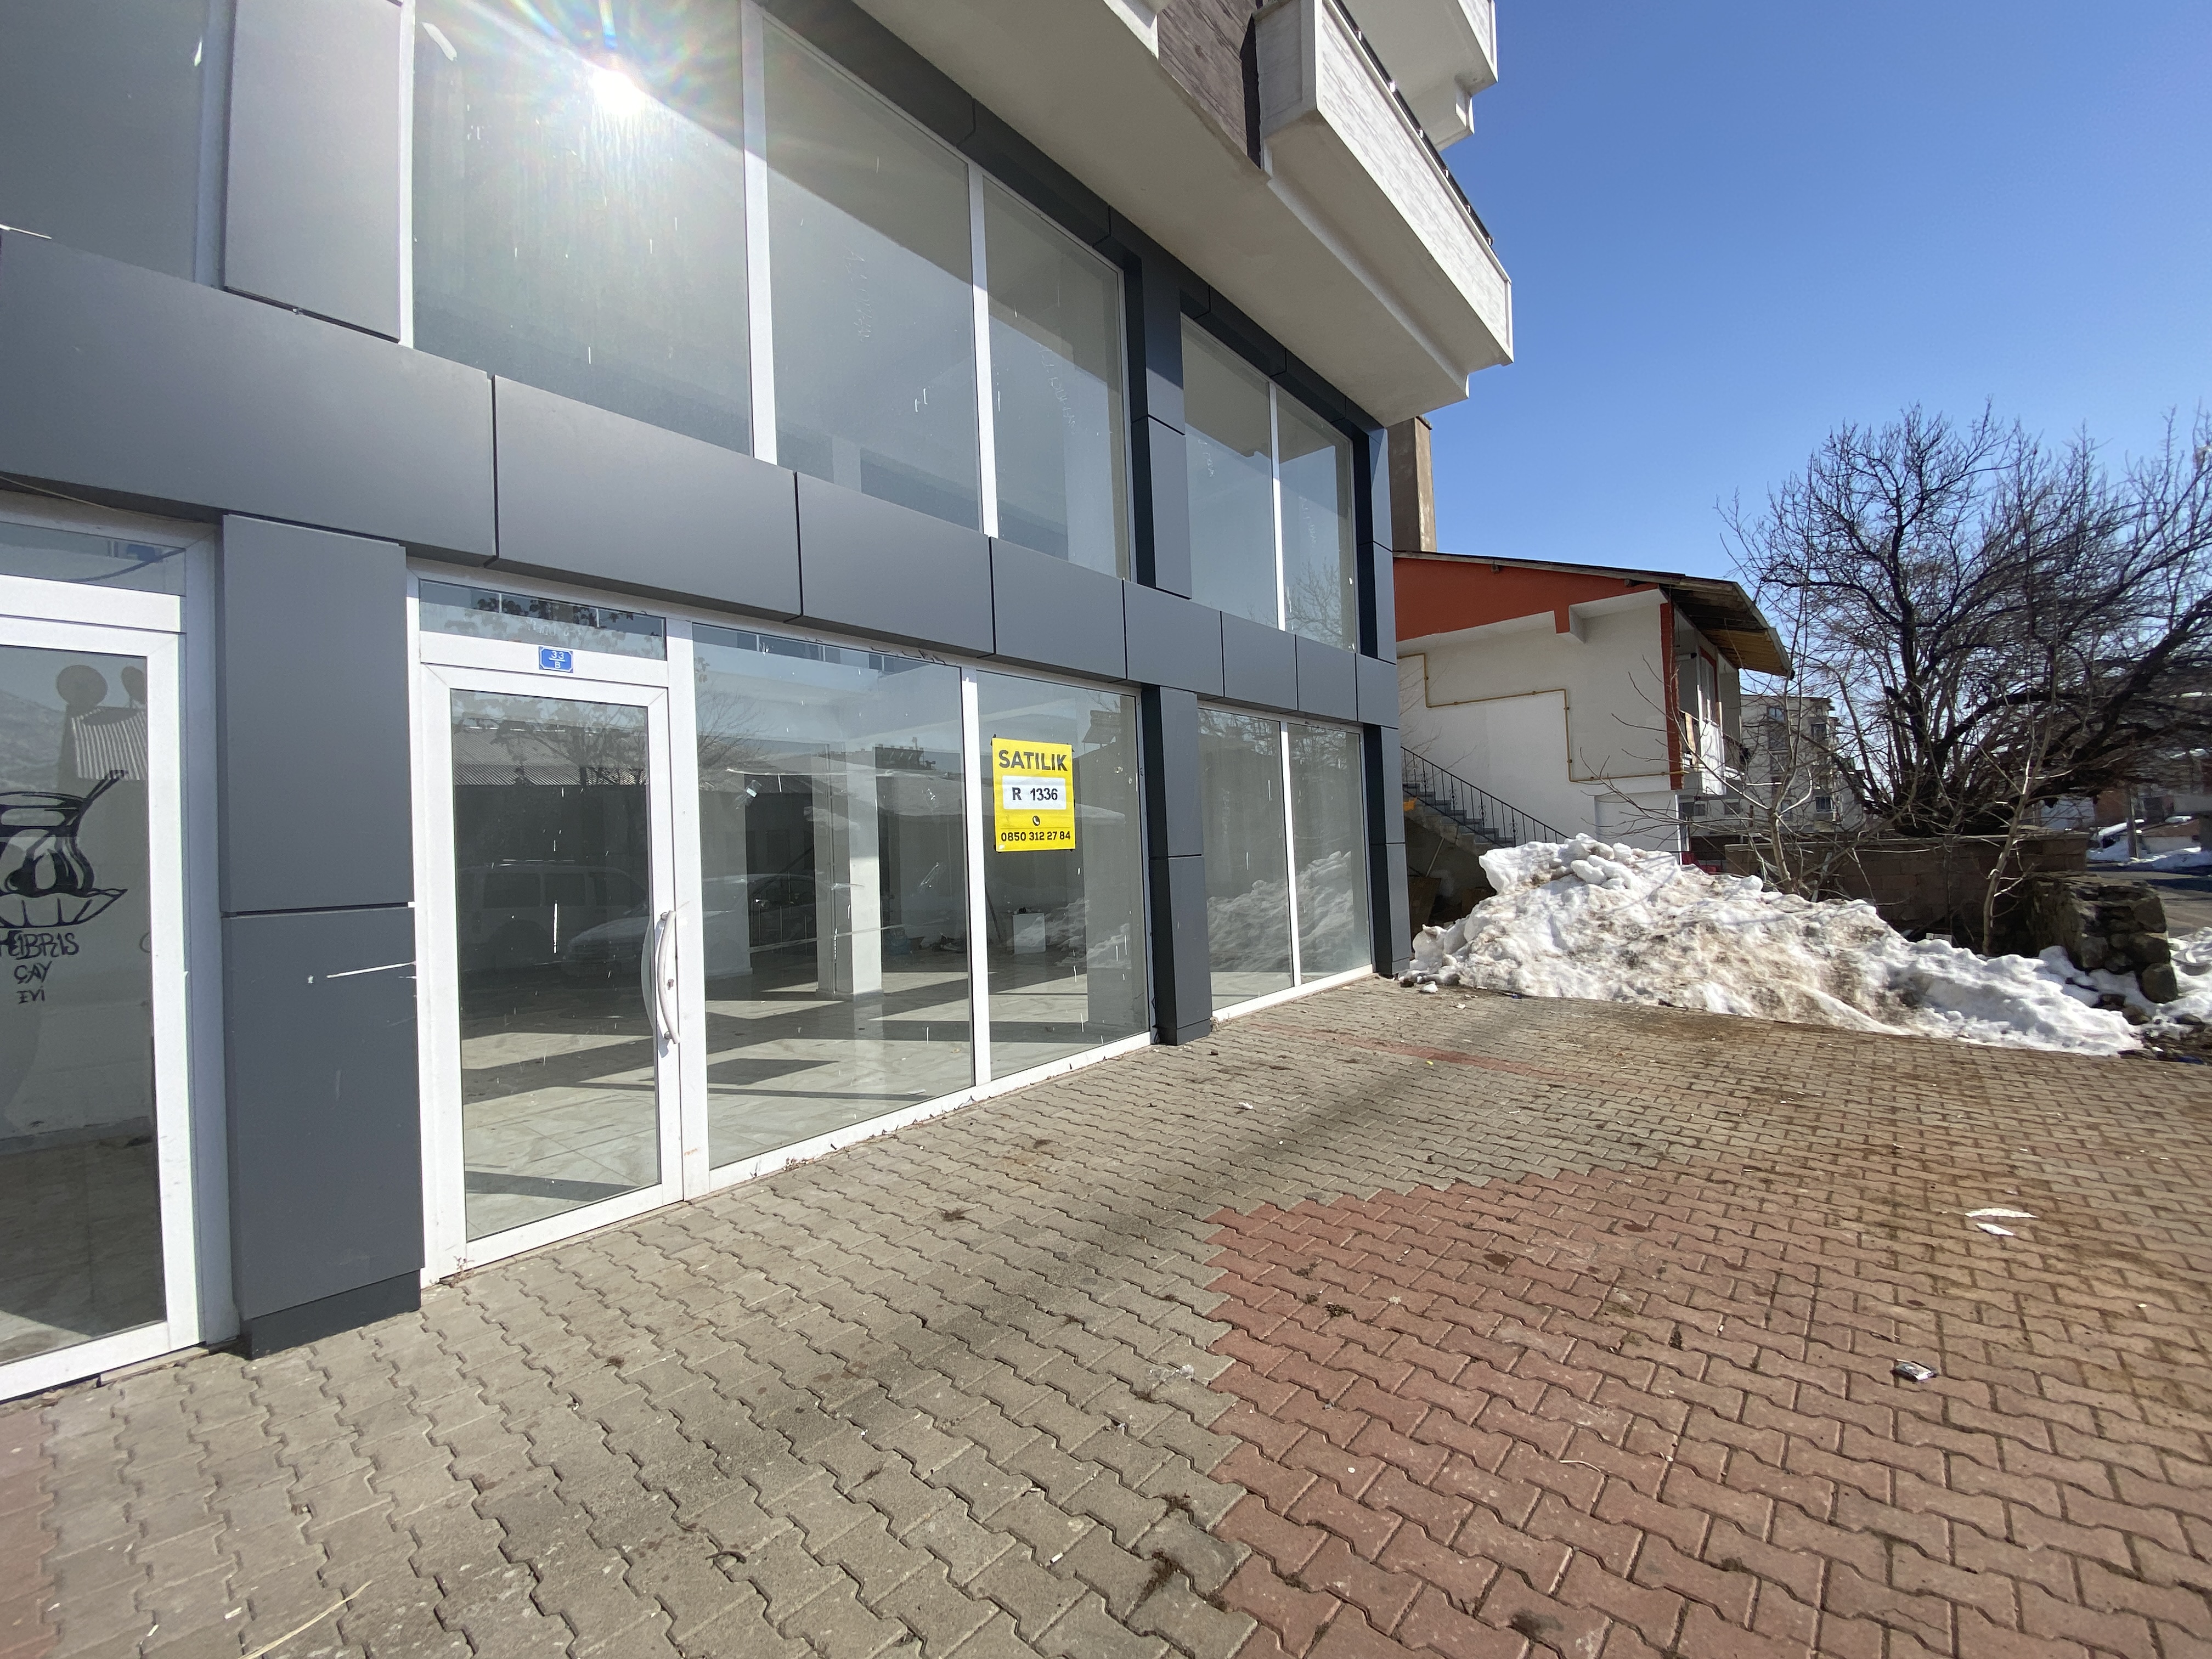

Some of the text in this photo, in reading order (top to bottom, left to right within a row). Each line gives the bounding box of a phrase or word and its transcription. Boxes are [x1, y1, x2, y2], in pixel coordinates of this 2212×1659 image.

[551, 651, 565, 660] 33
[998, 749, 1068, 771] SATILIK
[1012, 787, 1058, 801] R 1336
[1001, 831, 1071, 842] 0850 312 27 84
[14, 961, 53, 984] ÇAY
